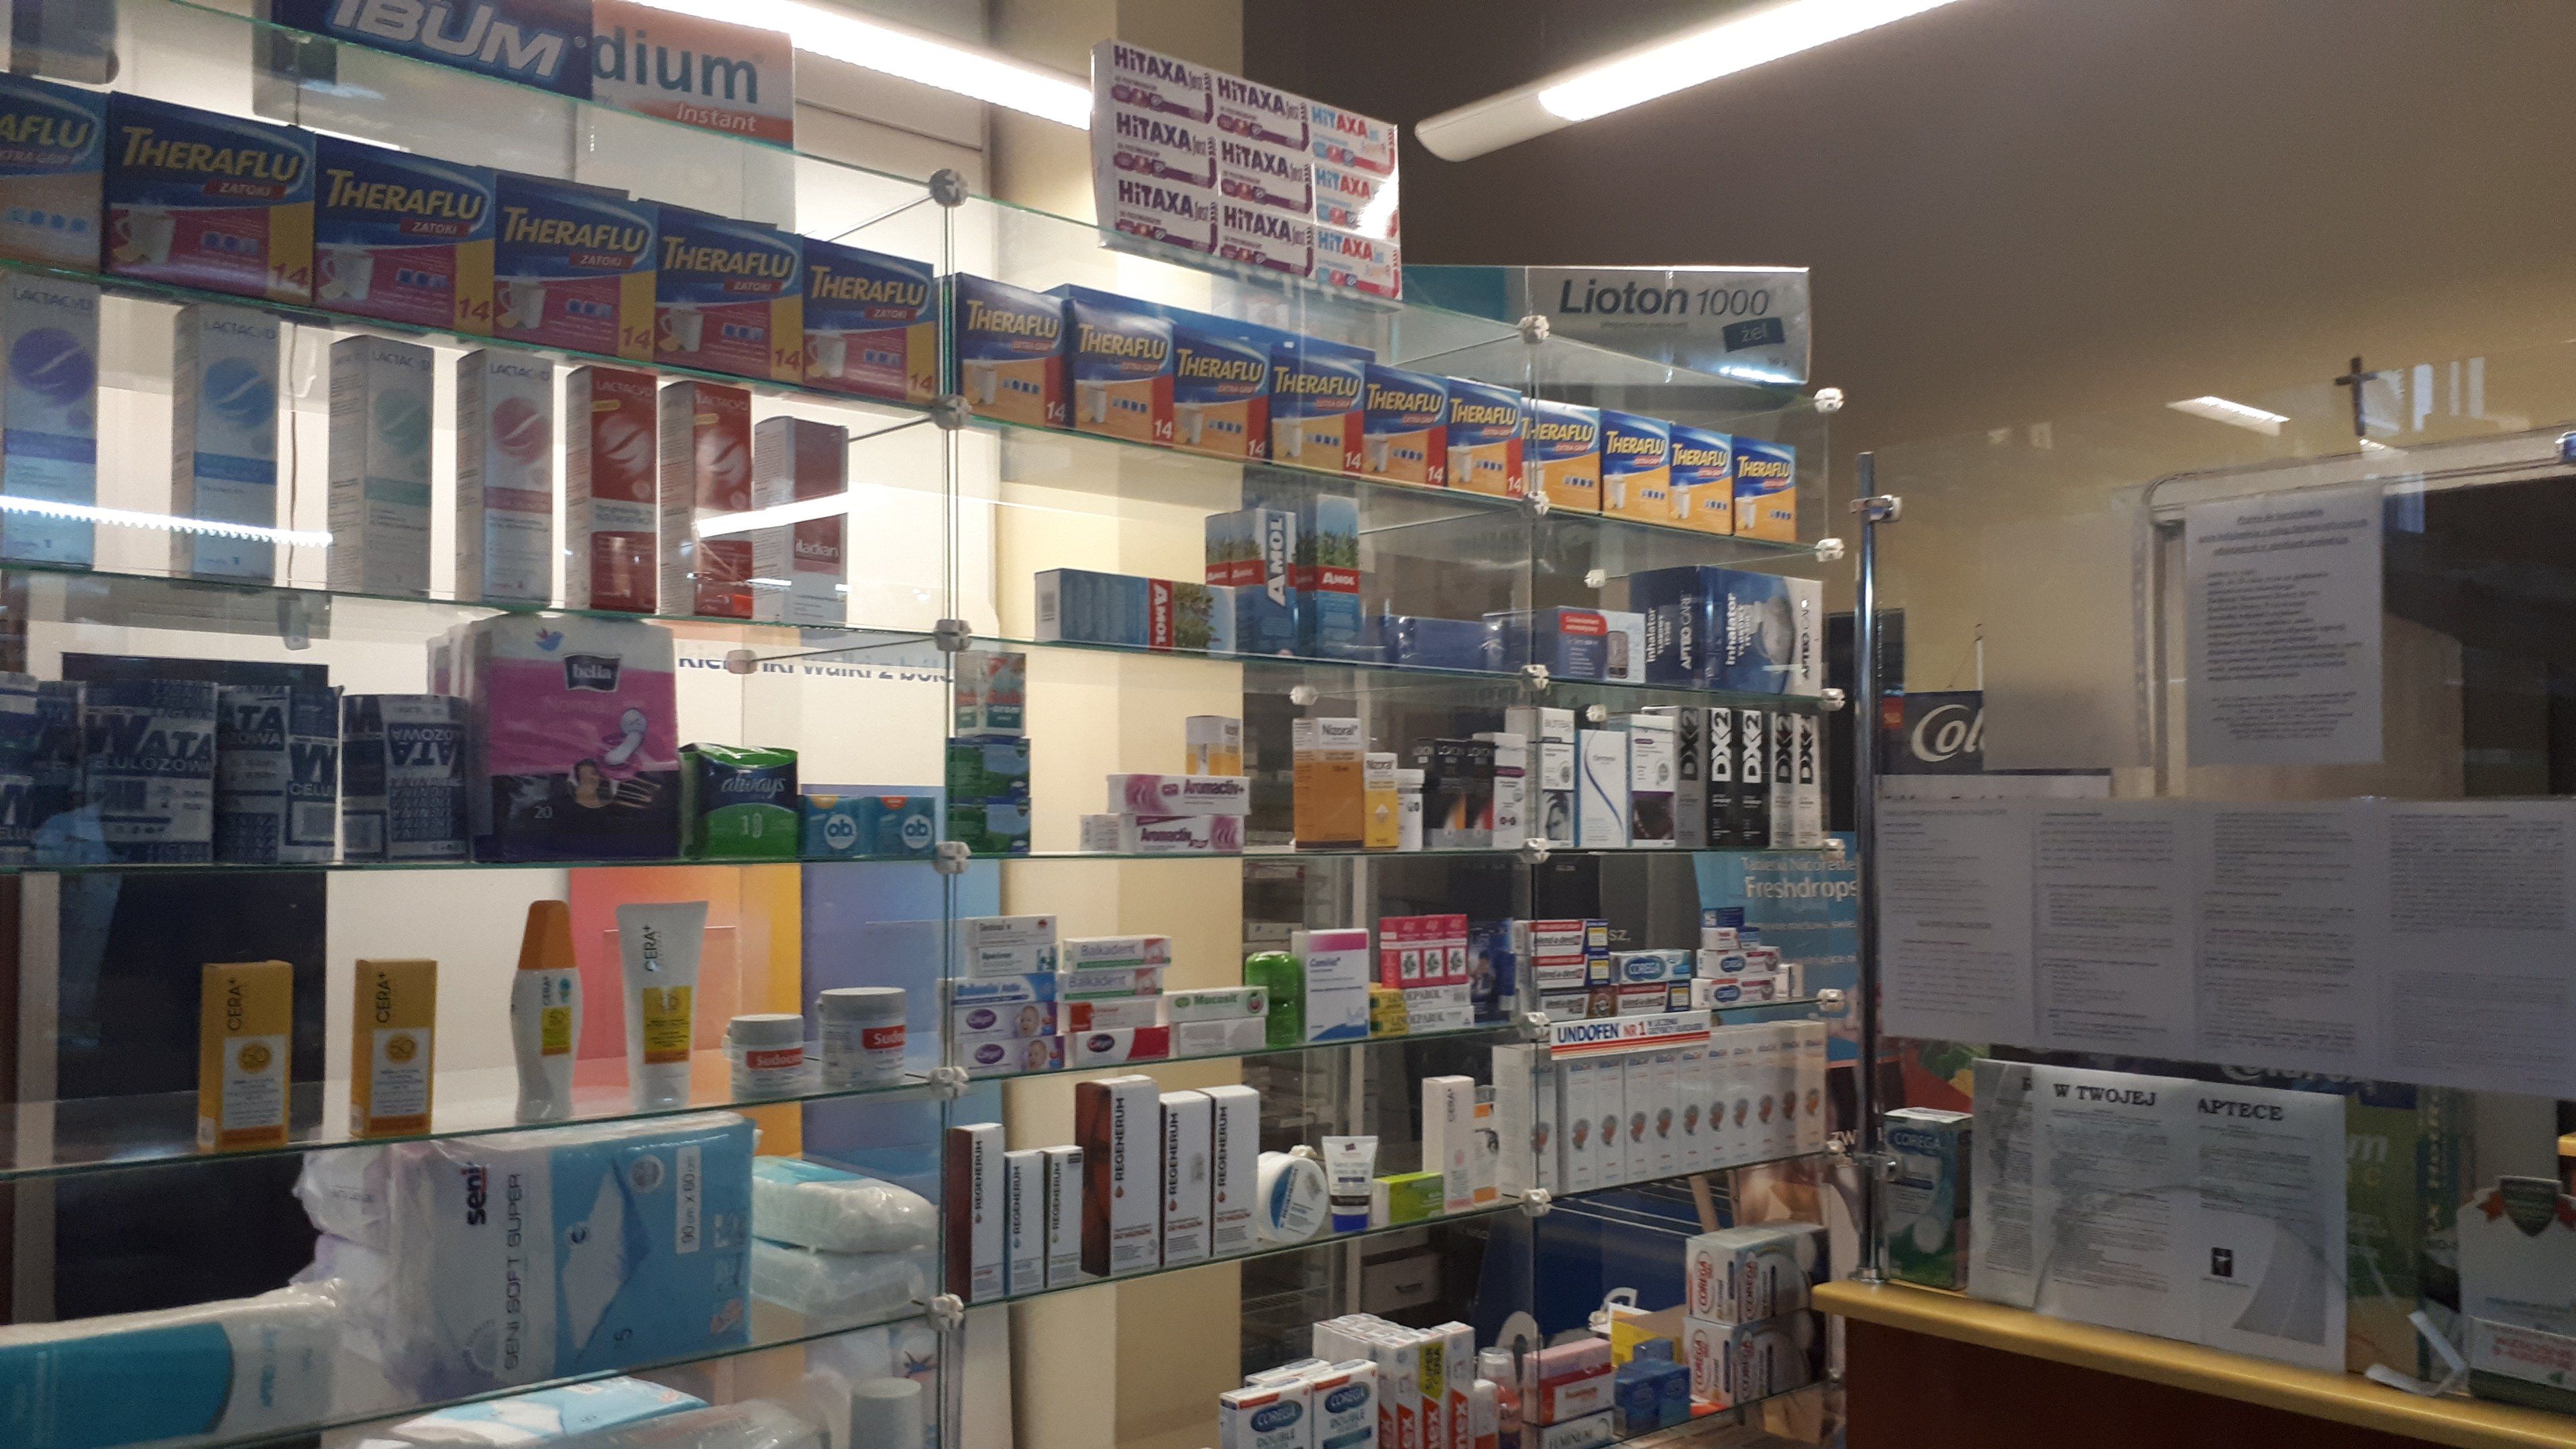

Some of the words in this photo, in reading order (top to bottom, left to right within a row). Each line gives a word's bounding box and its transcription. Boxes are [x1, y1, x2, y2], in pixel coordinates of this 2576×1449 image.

[332, 0, 564, 77] IBUM
[678, 102, 757, 132] Instant
[121, 127, 301, 182] THERAFLU
[327, 169, 483, 219] THERAFLU
[412, 221, 457, 234] ZATOKI
[504, 206, 646, 252] THERAFLU
[662, 235, 794, 278] THERAFLU
[271, 262, 311, 289] 14
[810, 265, 926, 306] THERAFLU
[458, 301, 490, 322] 14
[1560, 279, 1688, 315] Lioton
[1698, 289, 1769, 316] 1000
[967, 300, 1059, 339] THERAFLU
[620, 326, 651, 349] 14
[1080, 324, 1166, 359] THERAFLU
[775, 347, 801, 370] 14
[1177, 349, 1263, 382] THERAFLU
[910, 373, 933, 392] 14
[1275, 367, 1359, 396] THERAFLU
[1367, 384, 1442, 413] THERAFLU
[1047, 402, 1065, 419] 14
[1155, 419, 1173, 437] 14
[1450, 398, 1516, 425] THERAFLU
[1249, 439, 1265, 456] 14
[1521, 418, 1594, 442] THERAFLU
[1607, 431, 1665, 456] THERAFLU
[1345, 453, 1362, 469] 14
[1672, 443, 1727, 468] THERAFLU
[1737, 456, 1789, 479] THERAFLU
[1428, 466, 1444, 482] 14
[1508, 476, 1521, 492] 14
[1269, 517, 1286, 606] AMOL
[1154, 584, 1168, 645] AMOL
[1725, 592, 1737, 665] Inhalator
[1646, 607, 1656, 662] Inhalator
[572, 664, 612, 679] bella
[1713, 708, 1731, 782] DX2
[1743, 710, 1762, 784] DX2
[721, 774, 786, 798] always
[534, 806, 552, 818] 20
[1745, 875, 1858, 902] Freshdrops
[228, 977, 244, 1031] CERA+
[376, 971, 391, 1023] CERA+
[1558, 1023, 1620, 1044] UNDOFEN
[2054, 1084, 2070, 1098] W
[2080, 1085, 2156, 1107] TWOJEJ
[2198, 1097, 2284, 1120] APTECE
[1114, 1097, 1125, 1181] REGENERUM
[1169, 1112, 1179, 1195] REGENERUM
[1218, 1106, 1228, 1187] REGENERUM
[461, 1163, 488, 1226] seni
[506, 1173, 523, 1248] SUPER
[1014, 1166, 1022, 1234] REGENERUM
[1053, 1162, 1061, 1229] REGENERUM
[506, 1256, 521, 1314] SOFT
[504, 1320, 519, 1371] SENI
